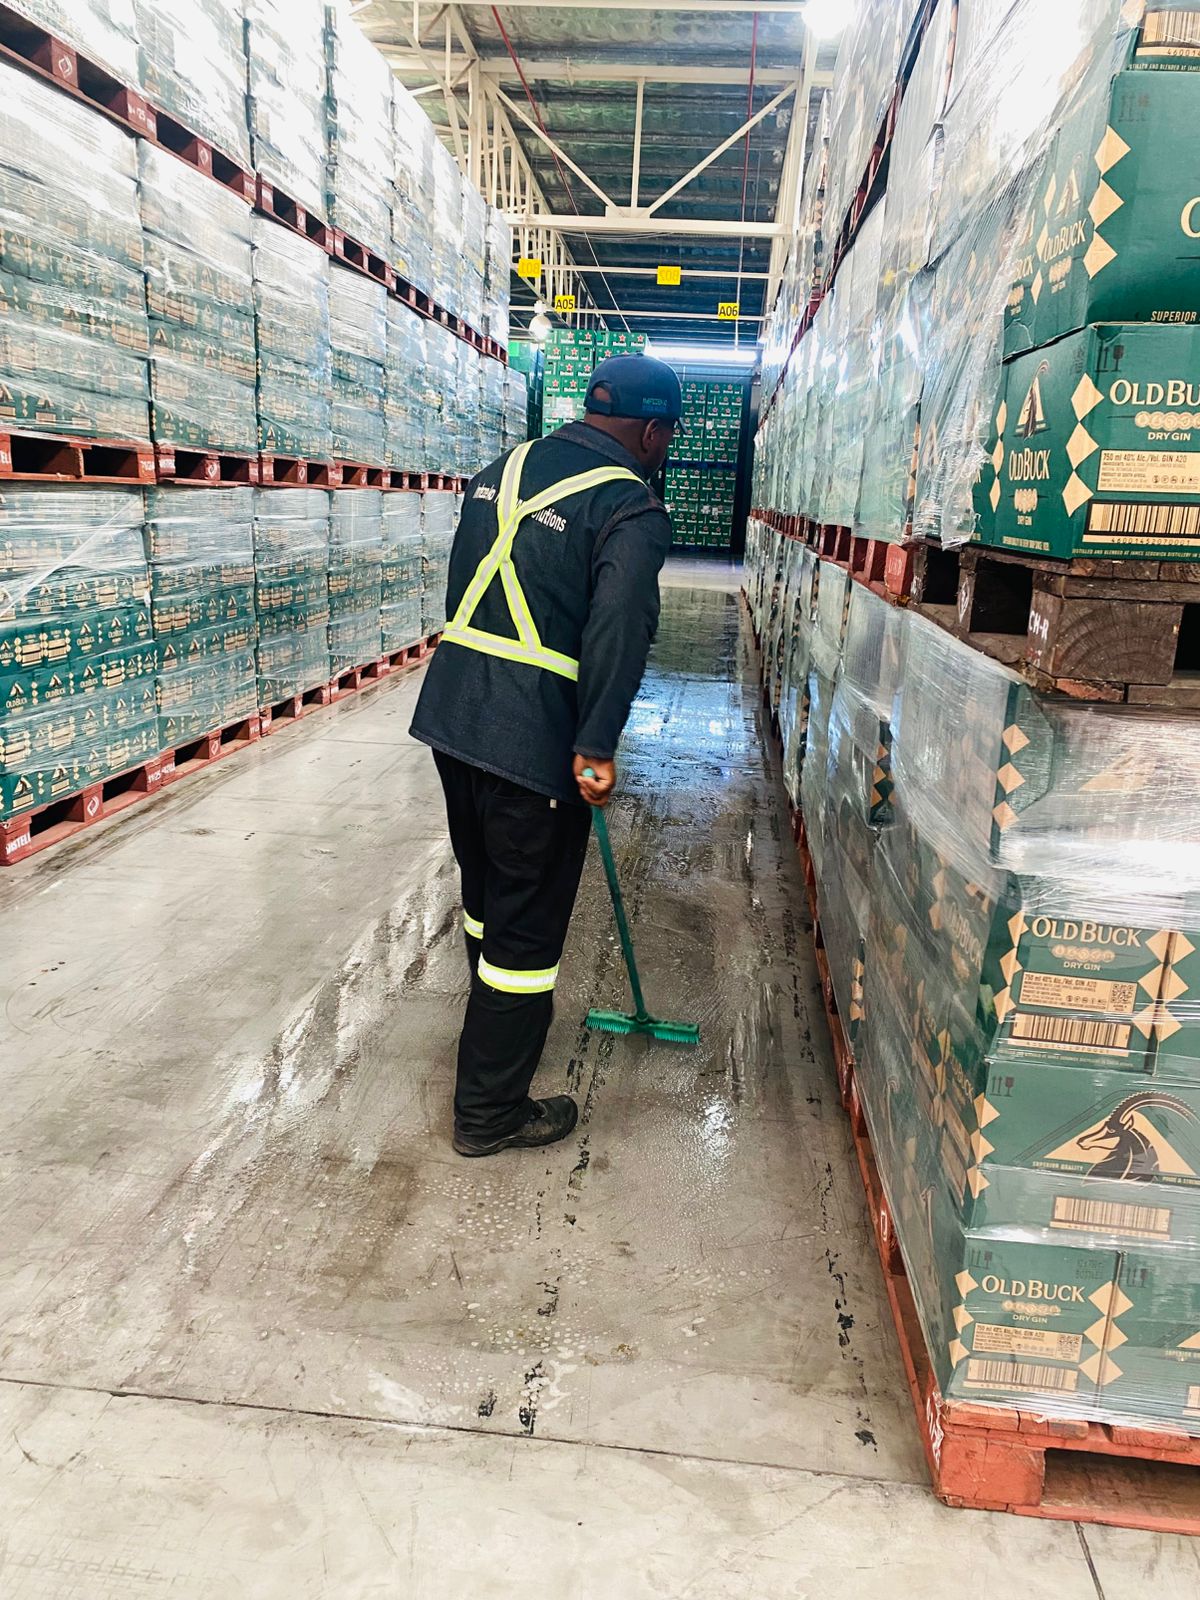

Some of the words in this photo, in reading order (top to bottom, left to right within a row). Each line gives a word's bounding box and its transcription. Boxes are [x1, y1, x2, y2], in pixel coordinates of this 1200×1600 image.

[555, 299, 574, 310] A05
[718, 305, 738, 317] A06
[1150, 310, 1197, 322] SUPERIOR
[1147, 432, 1170, 441] DRY
[1171, 432, 1191, 441] GIN
[1063, 960, 1082, 969] DRY
[1083, 963, 1101, 971] GIN
